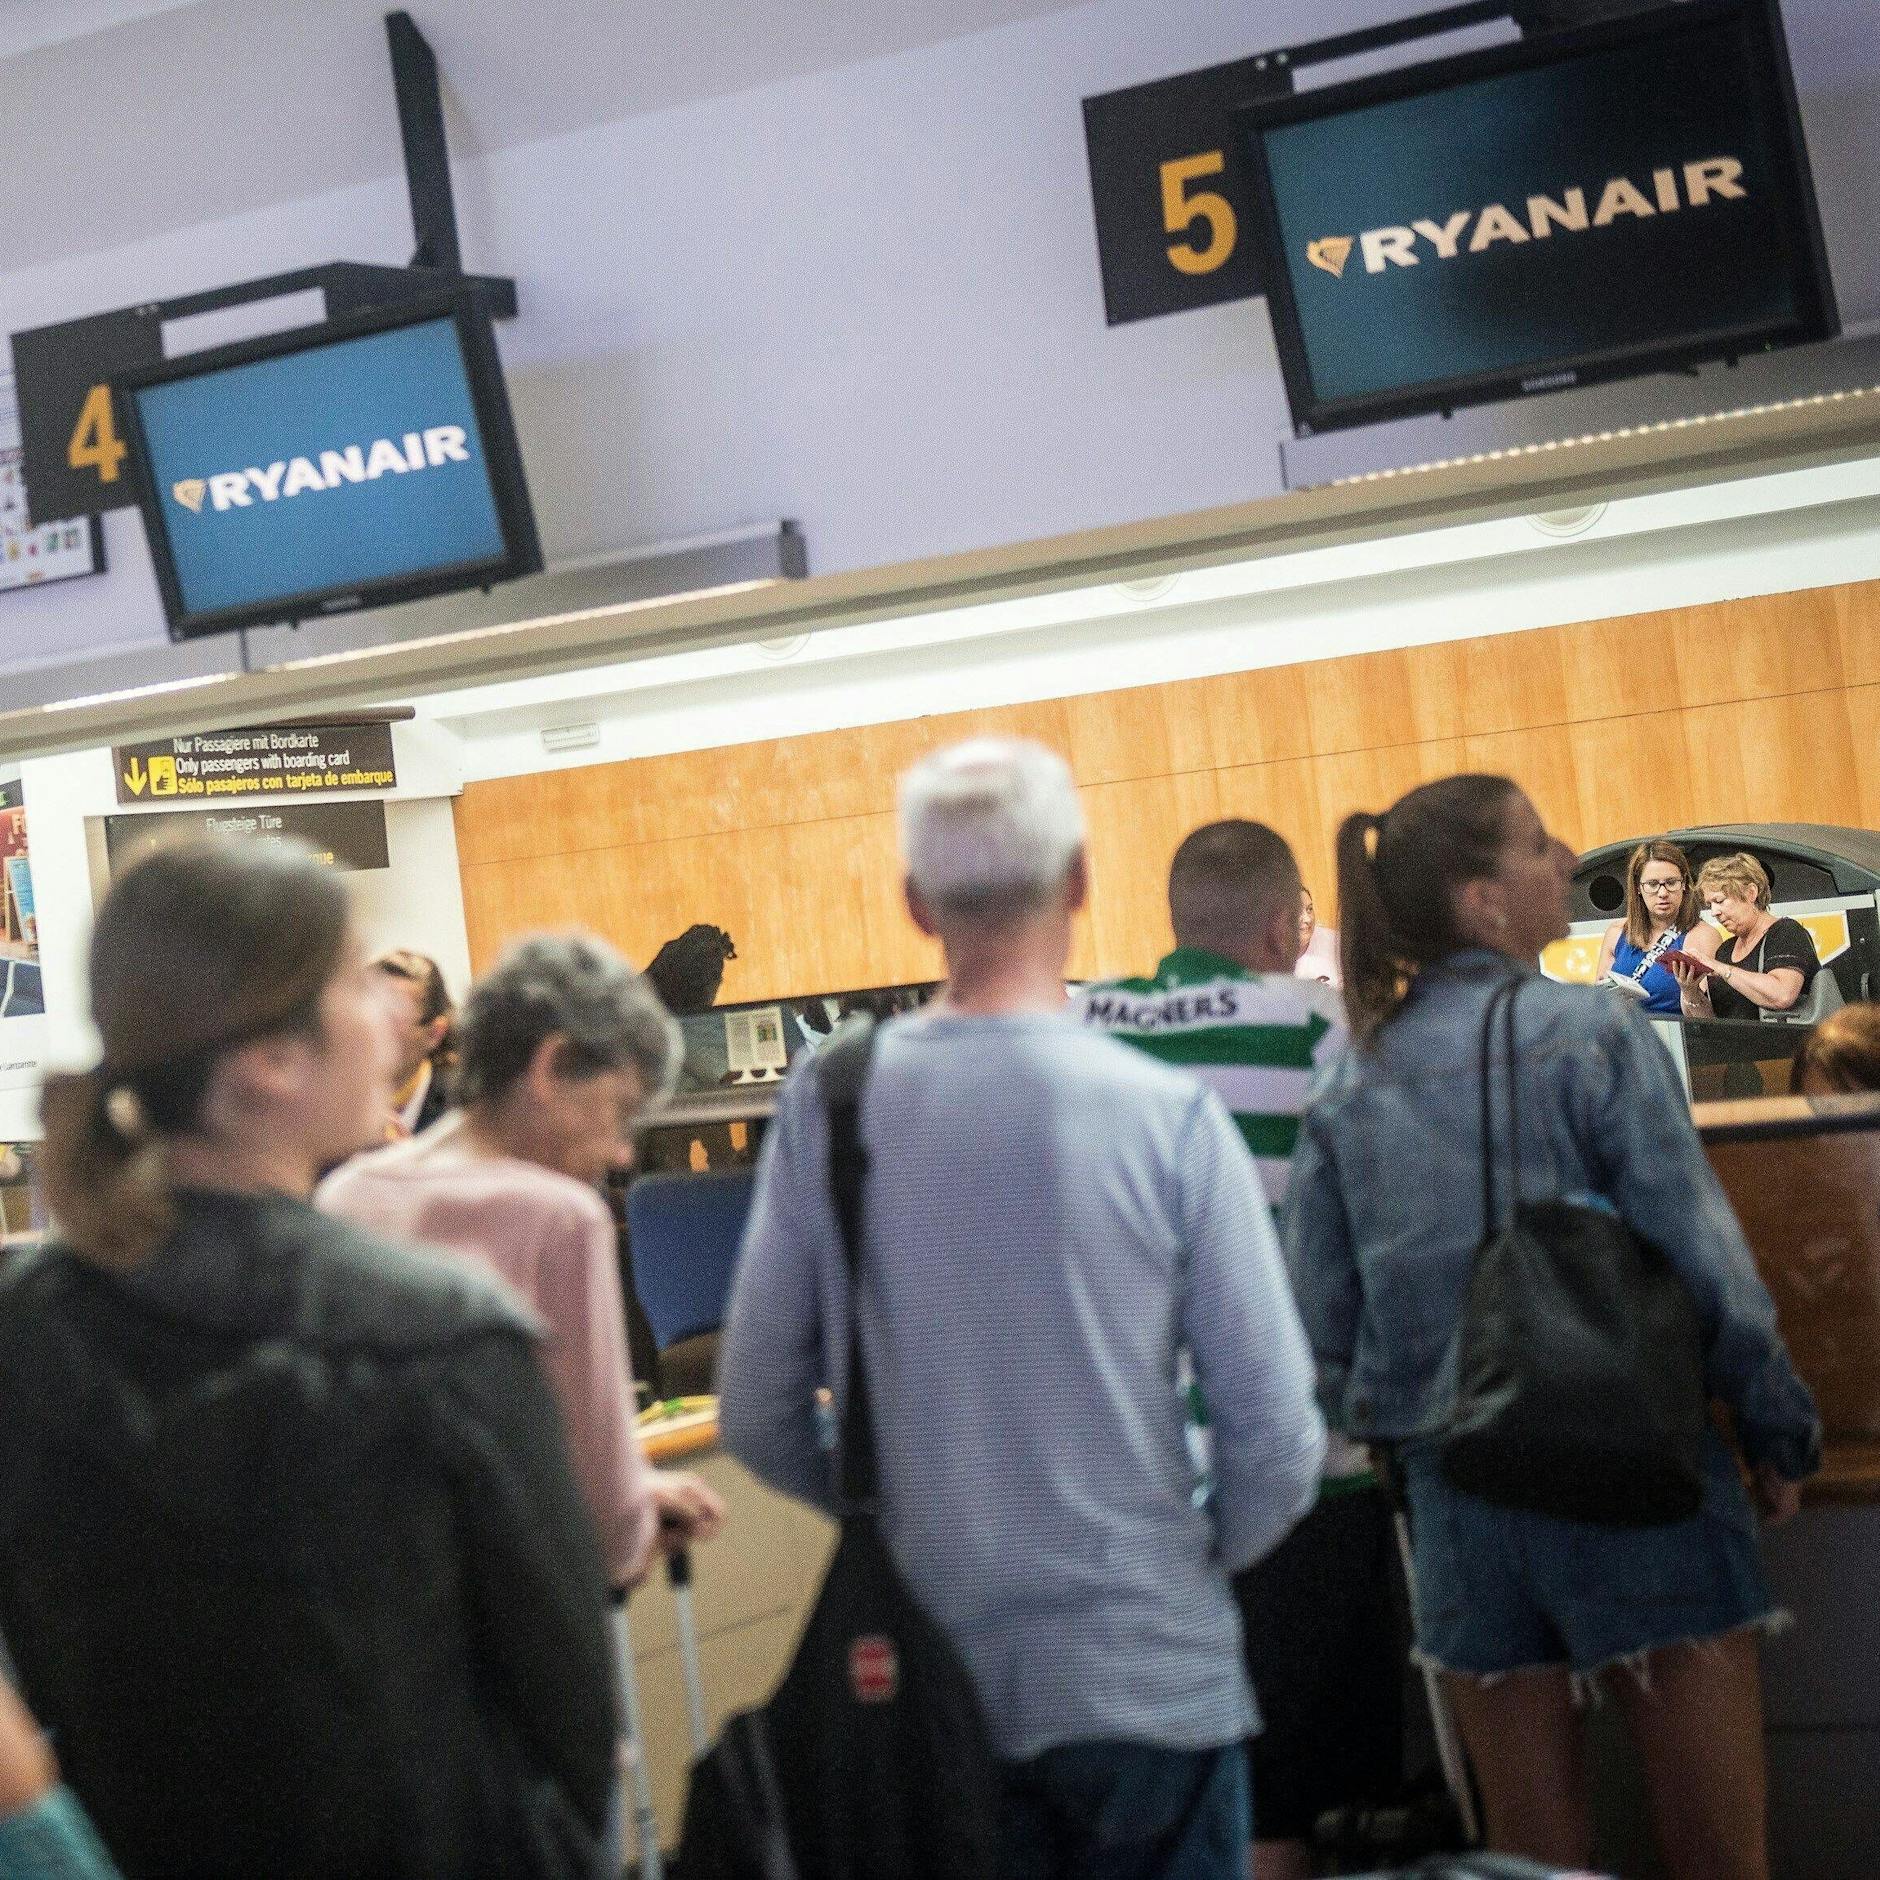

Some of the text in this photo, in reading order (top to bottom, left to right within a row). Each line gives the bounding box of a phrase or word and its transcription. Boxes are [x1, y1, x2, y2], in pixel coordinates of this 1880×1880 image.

[1160, 150, 1238, 275] 5
[1359, 156, 1748, 275] RYANAIR
[67, 383, 128, 483] 4
[208, 424, 471, 511] RYANAIR
[173, 732, 320, 755] Nur Passagiere mit Bordkarte
[176, 749, 350, 776] Only passengers with boarding card
[178, 768, 394, 796] Sólo pasajeros con tarjeta de embarque
[1084, 986, 1238, 1028] MAGNERS
